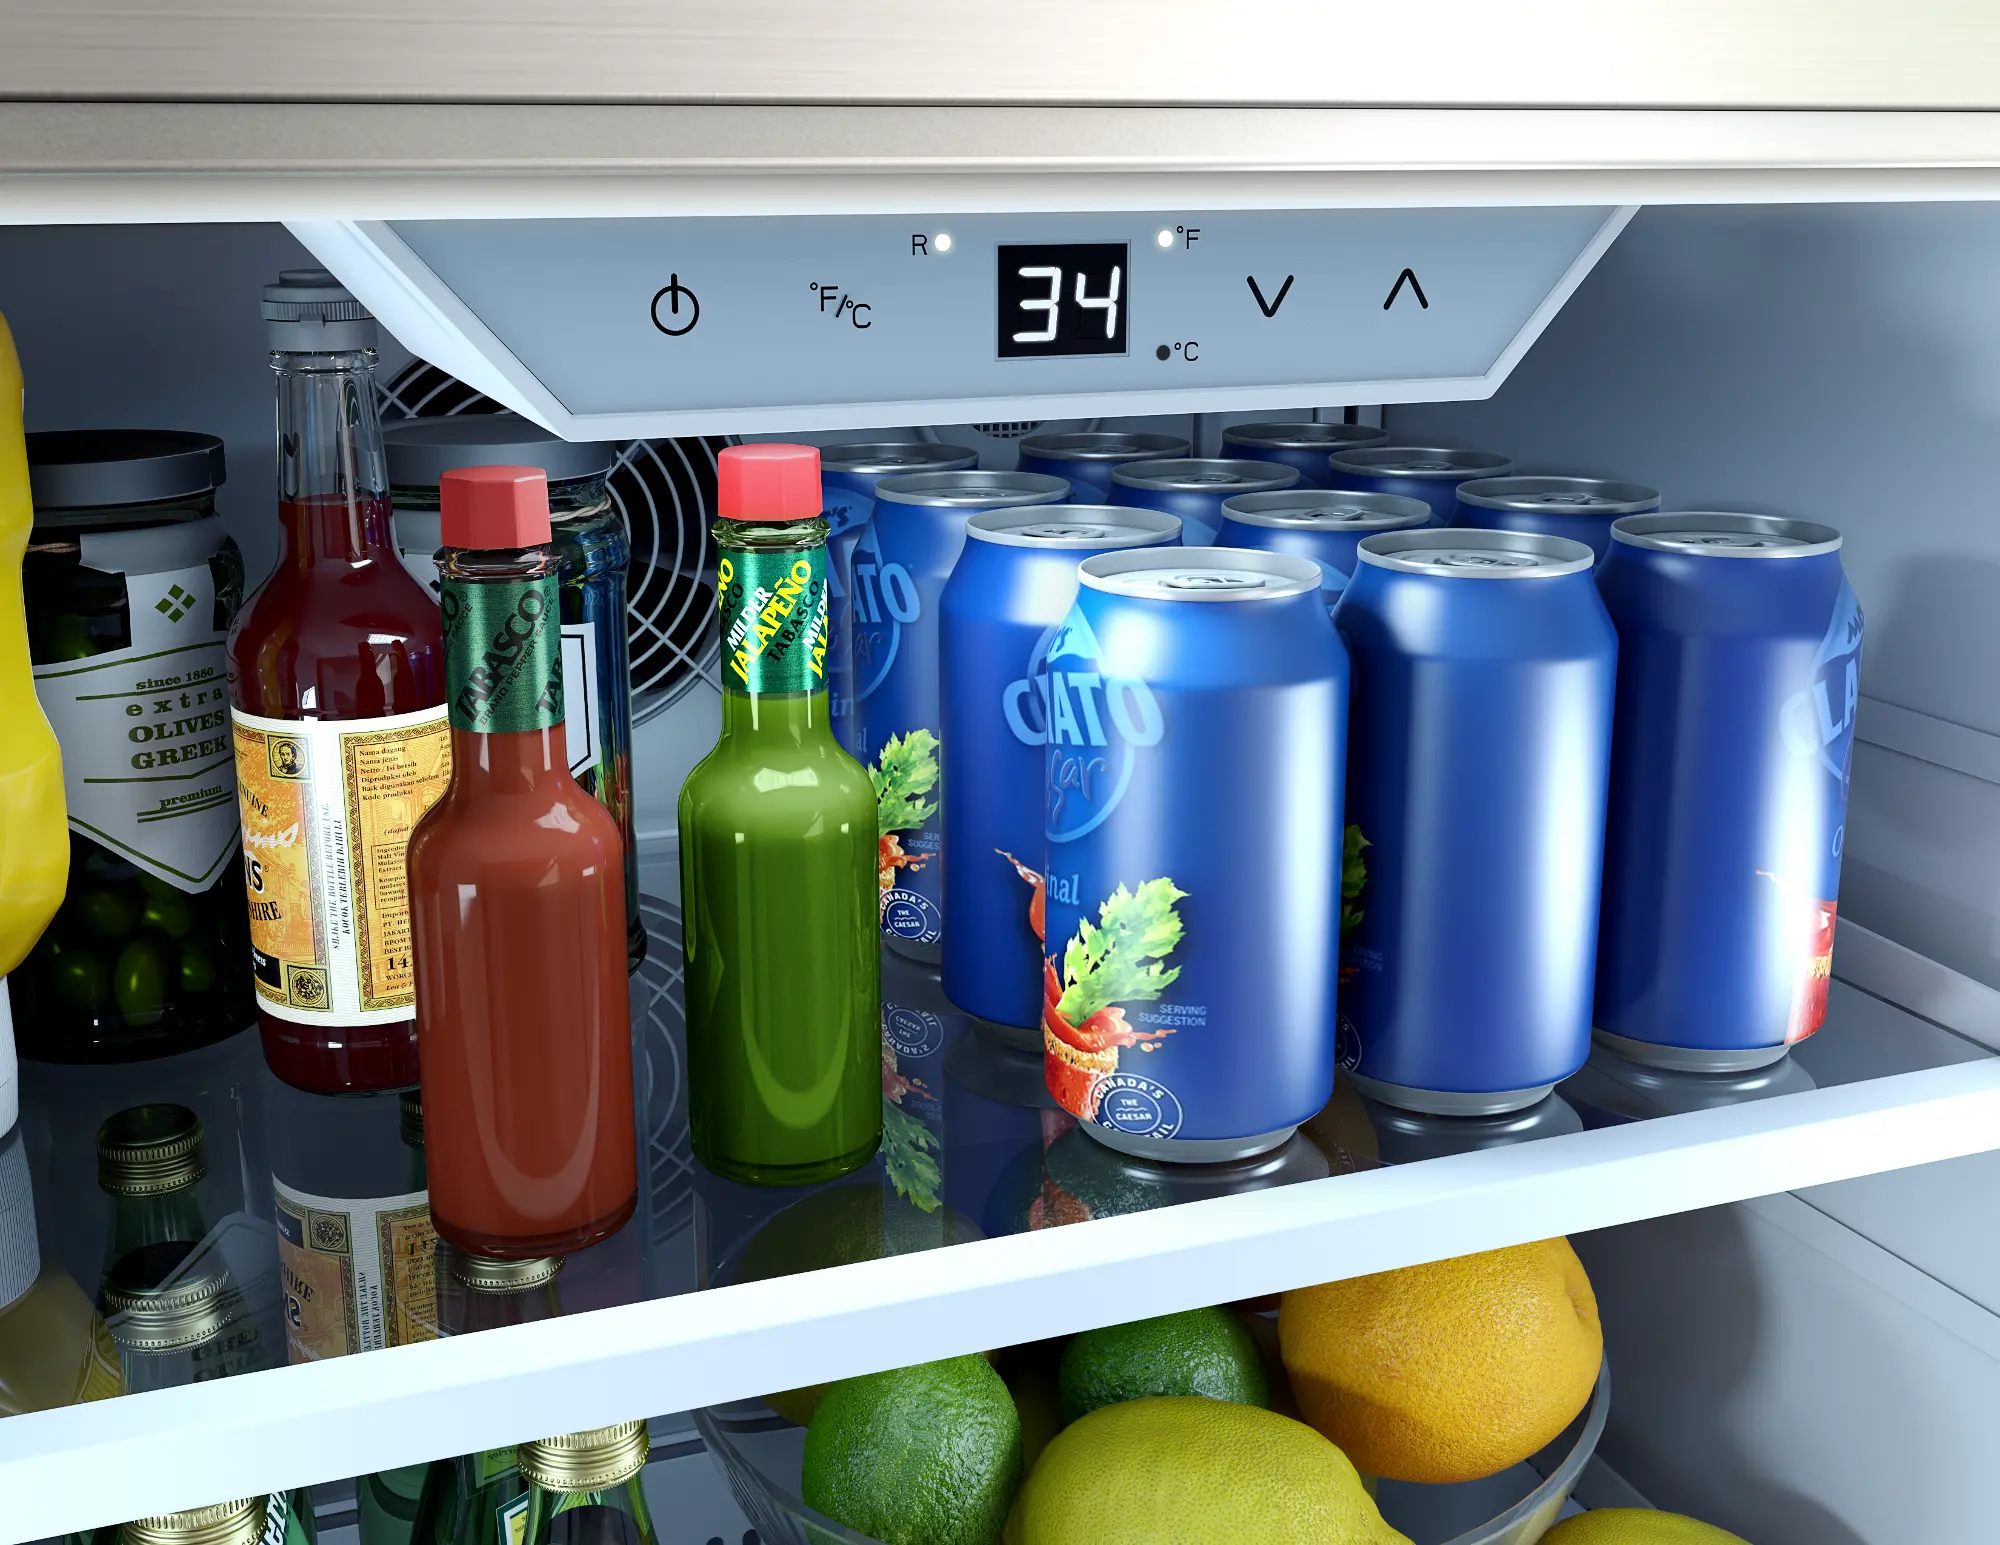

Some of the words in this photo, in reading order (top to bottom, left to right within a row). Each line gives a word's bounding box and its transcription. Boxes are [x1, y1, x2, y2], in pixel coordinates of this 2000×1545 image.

[911, 234, 928, 256] R
[1012, 265, 1120, 342] 34
[727, 586, 773, 651] MILDER
[730, 559, 811, 685] JALAPEÑO
[479, 687, 507, 726] BRAND
[506, 639, 537, 686] PEPPER
[535, 597, 554, 638] SAUCE
[135, 676, 181, 690] since
[126, 688, 223, 716] extra
[128, 709, 225, 743] OLIVES
[131, 734, 228, 769] GREEK
[159, 785, 222, 811] premium
[376, 845, 407, 854] Ingredie
[383, 928, 410, 937] JAKART
[1138, 1012, 1206, 1027] SUGGESTION
[1159, 1004, 1207, 1016] SERVING
[1094, 1077, 1165, 1099] CANADA'S
[1115, 1112, 1152, 1121] CAESAR
